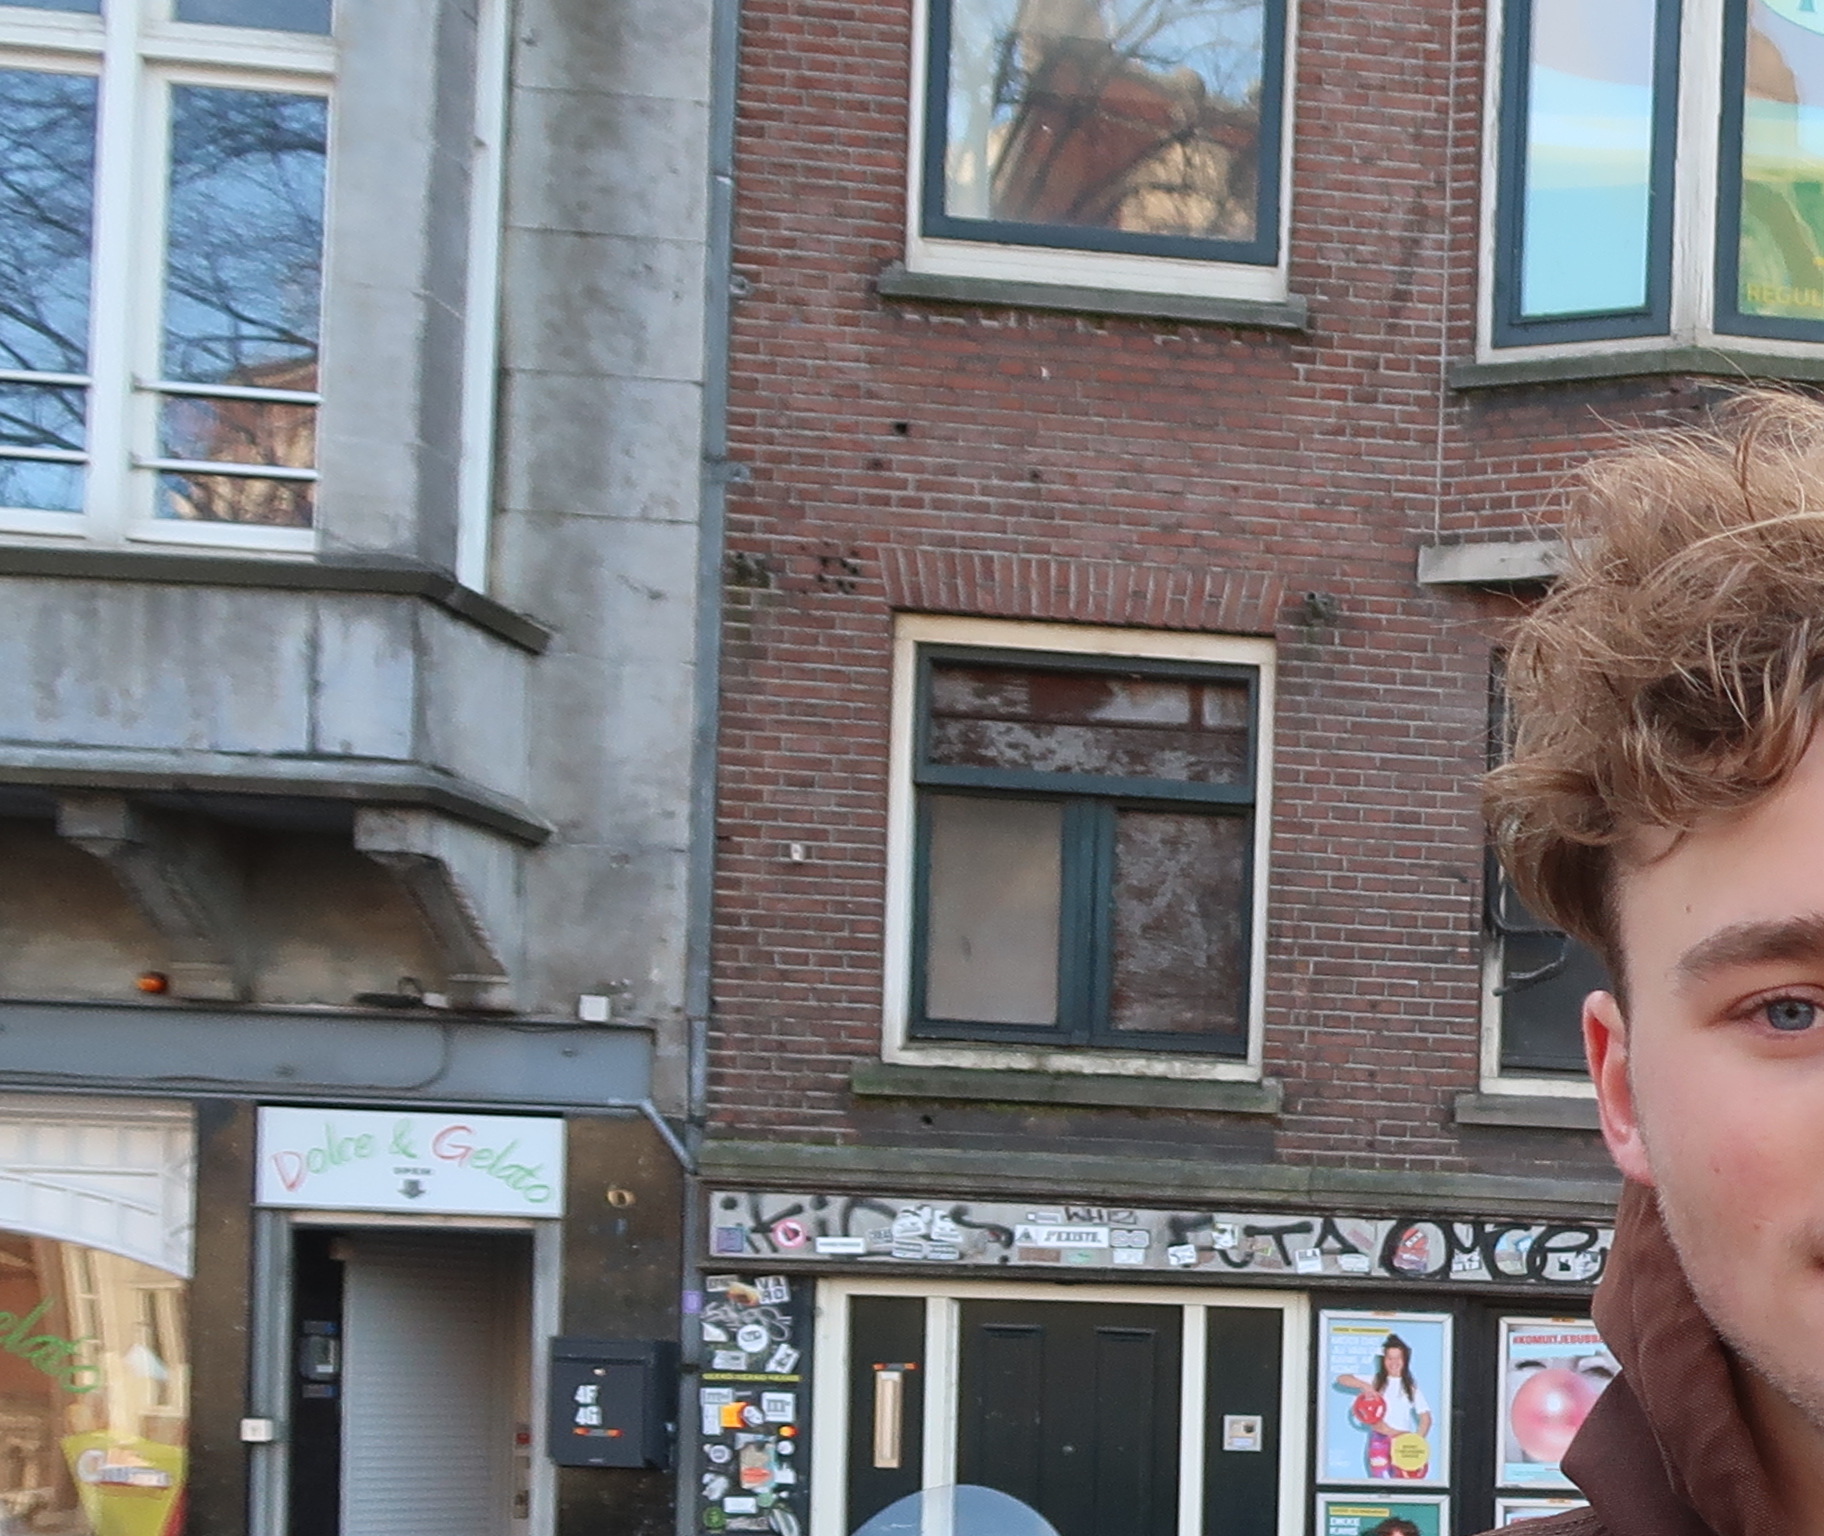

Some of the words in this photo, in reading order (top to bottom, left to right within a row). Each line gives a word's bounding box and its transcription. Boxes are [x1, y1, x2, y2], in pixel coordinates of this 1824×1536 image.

[271, 1120, 374, 1192] Dolce
[388, 1118, 419, 1159] &
[431, 1124, 552, 1203] Gelato
